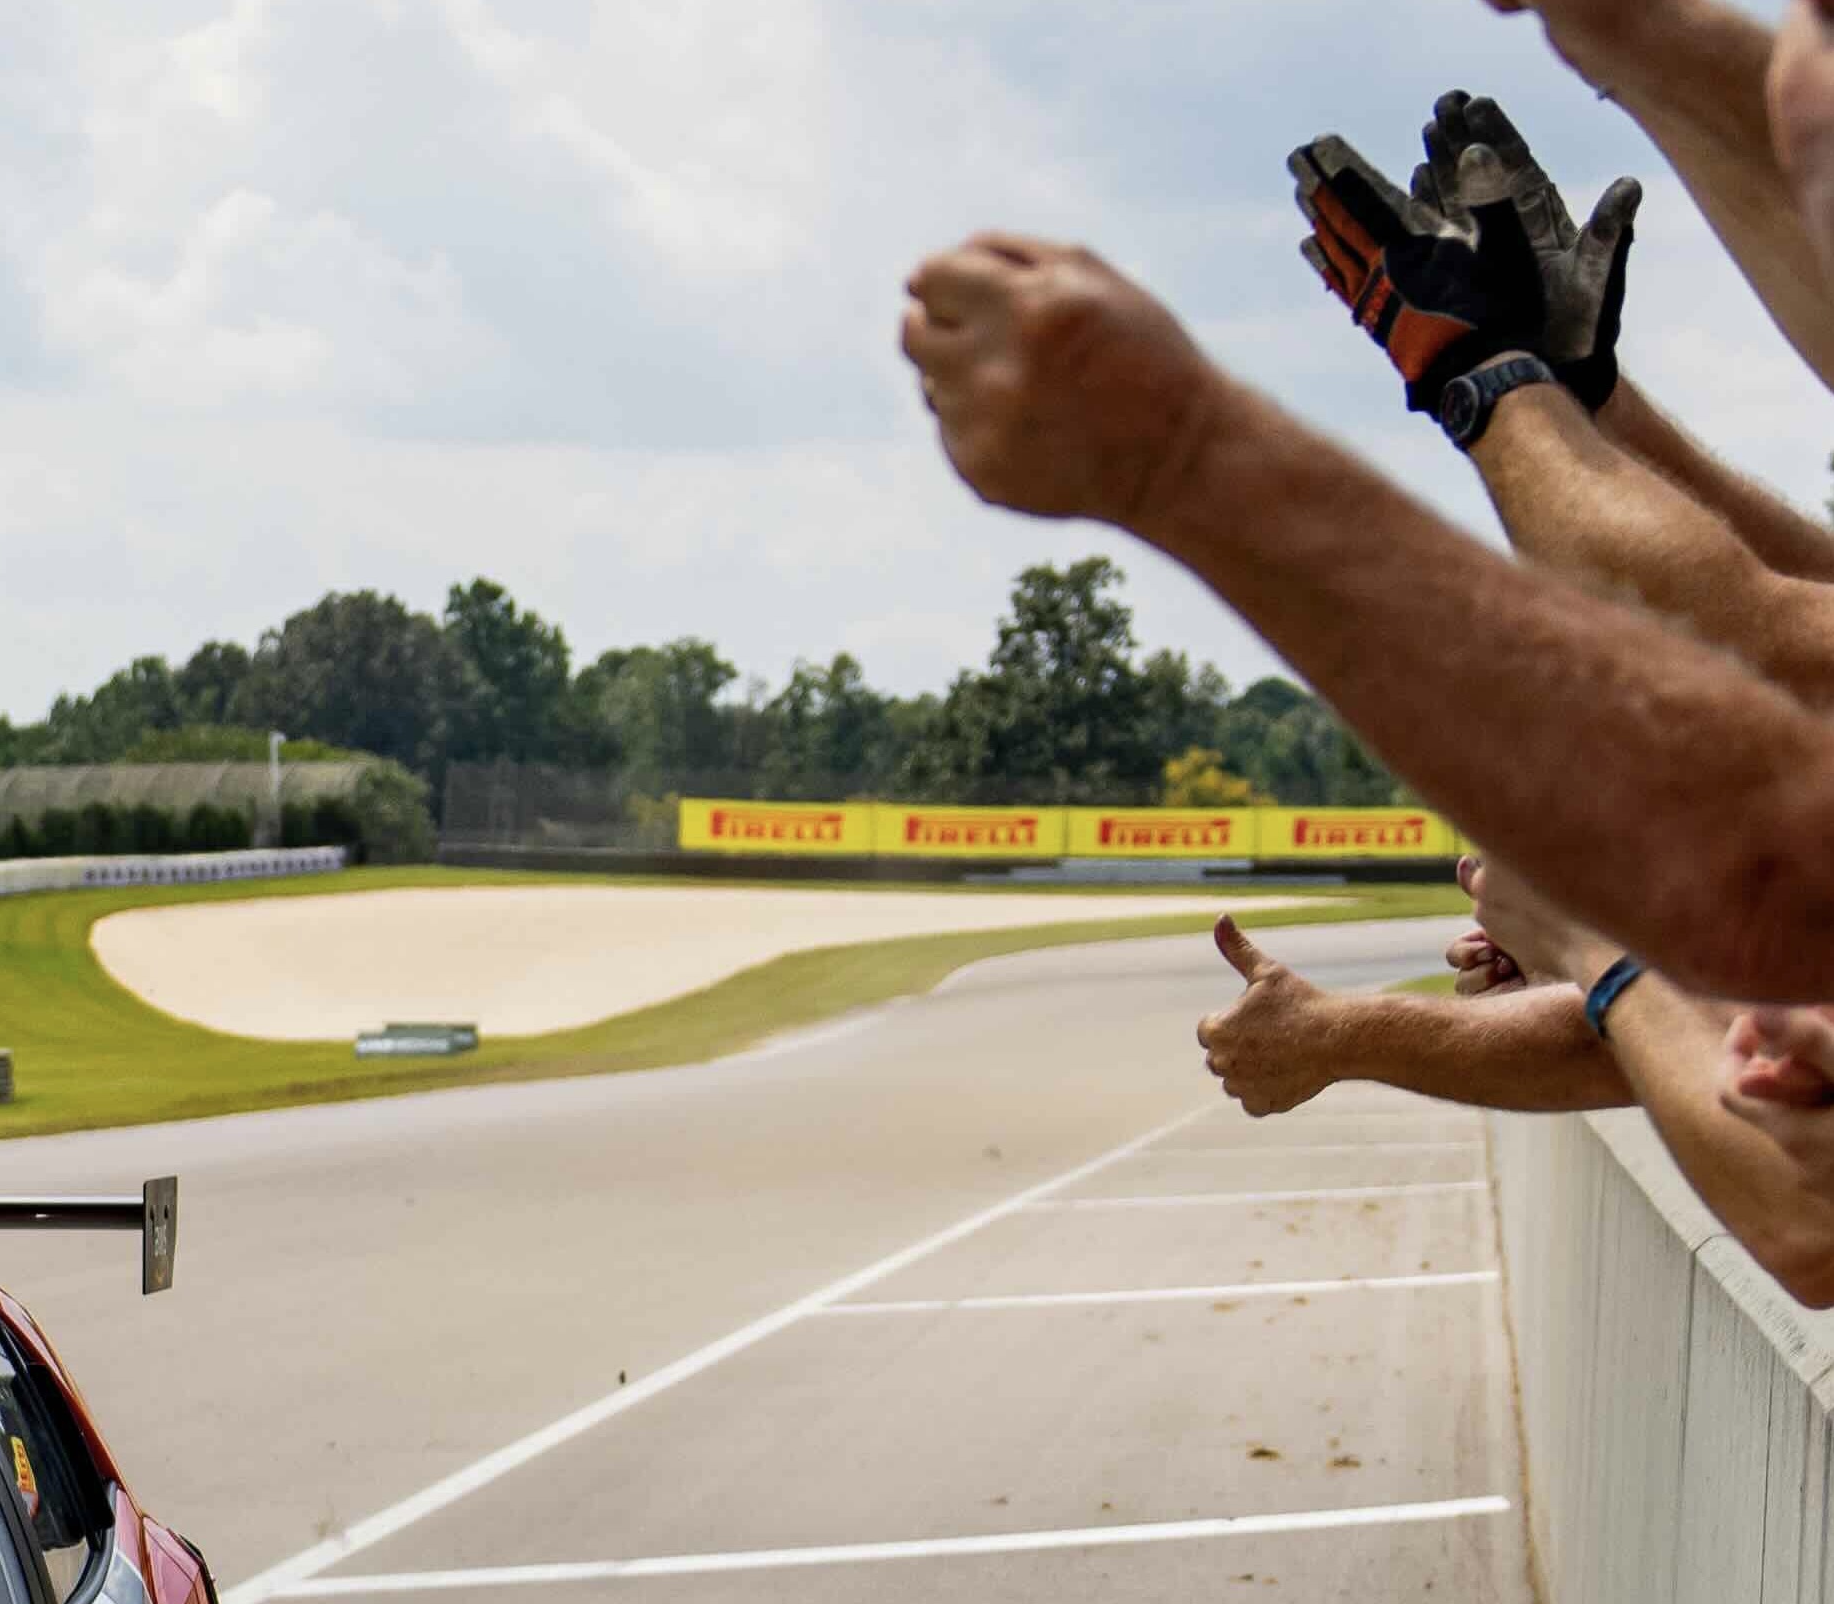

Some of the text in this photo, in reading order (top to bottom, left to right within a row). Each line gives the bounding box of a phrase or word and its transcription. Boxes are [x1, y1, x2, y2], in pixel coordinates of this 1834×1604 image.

[709, 809, 845, 842] PIRELLI
[905, 814, 1038, 846] PIRELLI
[1097, 817, 1230, 848] PIRELLI
[1293, 816, 1427, 847] PIRELLI
